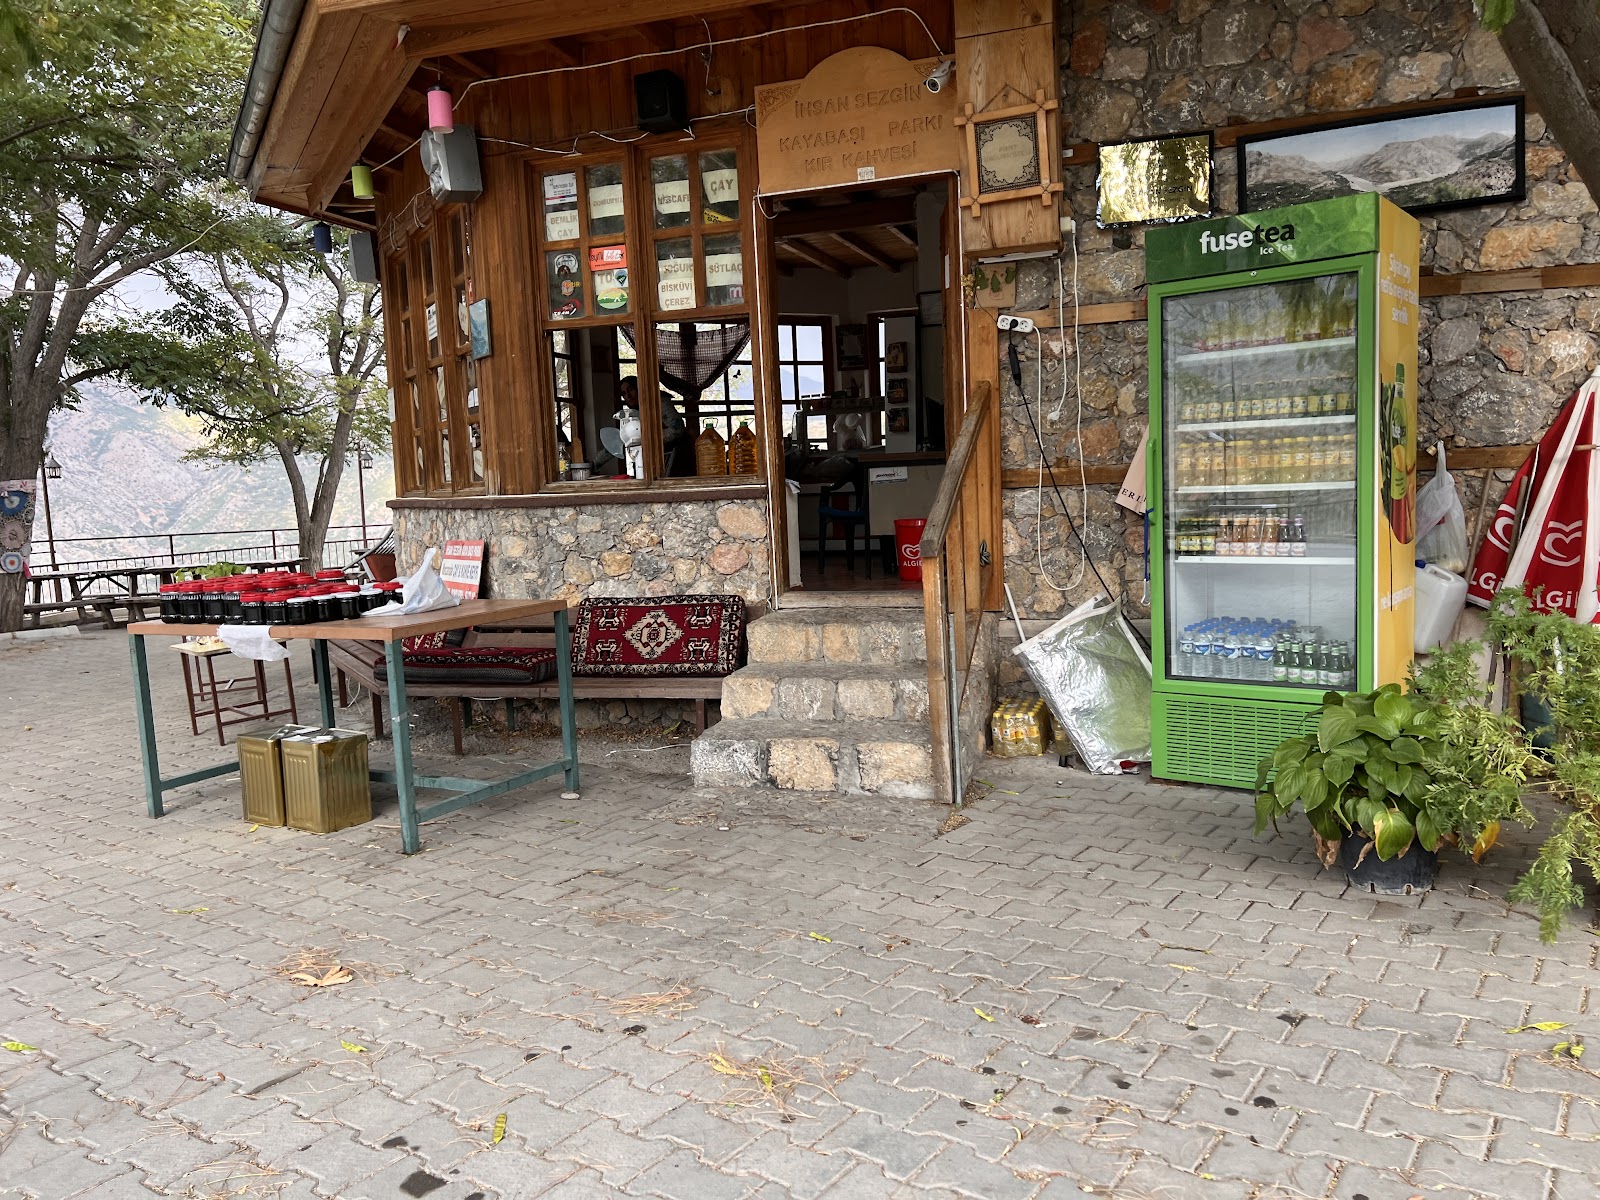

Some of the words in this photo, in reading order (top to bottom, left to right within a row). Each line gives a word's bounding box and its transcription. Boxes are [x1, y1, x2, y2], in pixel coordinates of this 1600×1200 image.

[795, 95, 848, 118] İHSAN
[855, 84, 921, 110] SEZGİN
[779, 126, 865, 152] KAYABAŞI
[889, 115, 943, 136] PARKI
[805, 155, 833, 174] KIR
[842, 141, 918, 167] KAHVESİ
[710, 179, 734, 195] ÇAY
[550, 212, 578, 225] DEMLİK
[557, 229, 574, 239] ÇAY
[1199, 223, 1296, 254] fusetea
[1260, 246, 1274, 255] Ice
[1276, 243, 1293, 252] Tea
[598, 272, 614, 284] TO
[661, 280, 693, 293] BİSKÜVİ
[664, 297, 691, 308] ÇEREZ
[1469, 567, 1505, 594] LGi
[1531, 590, 1579, 609] LGi
